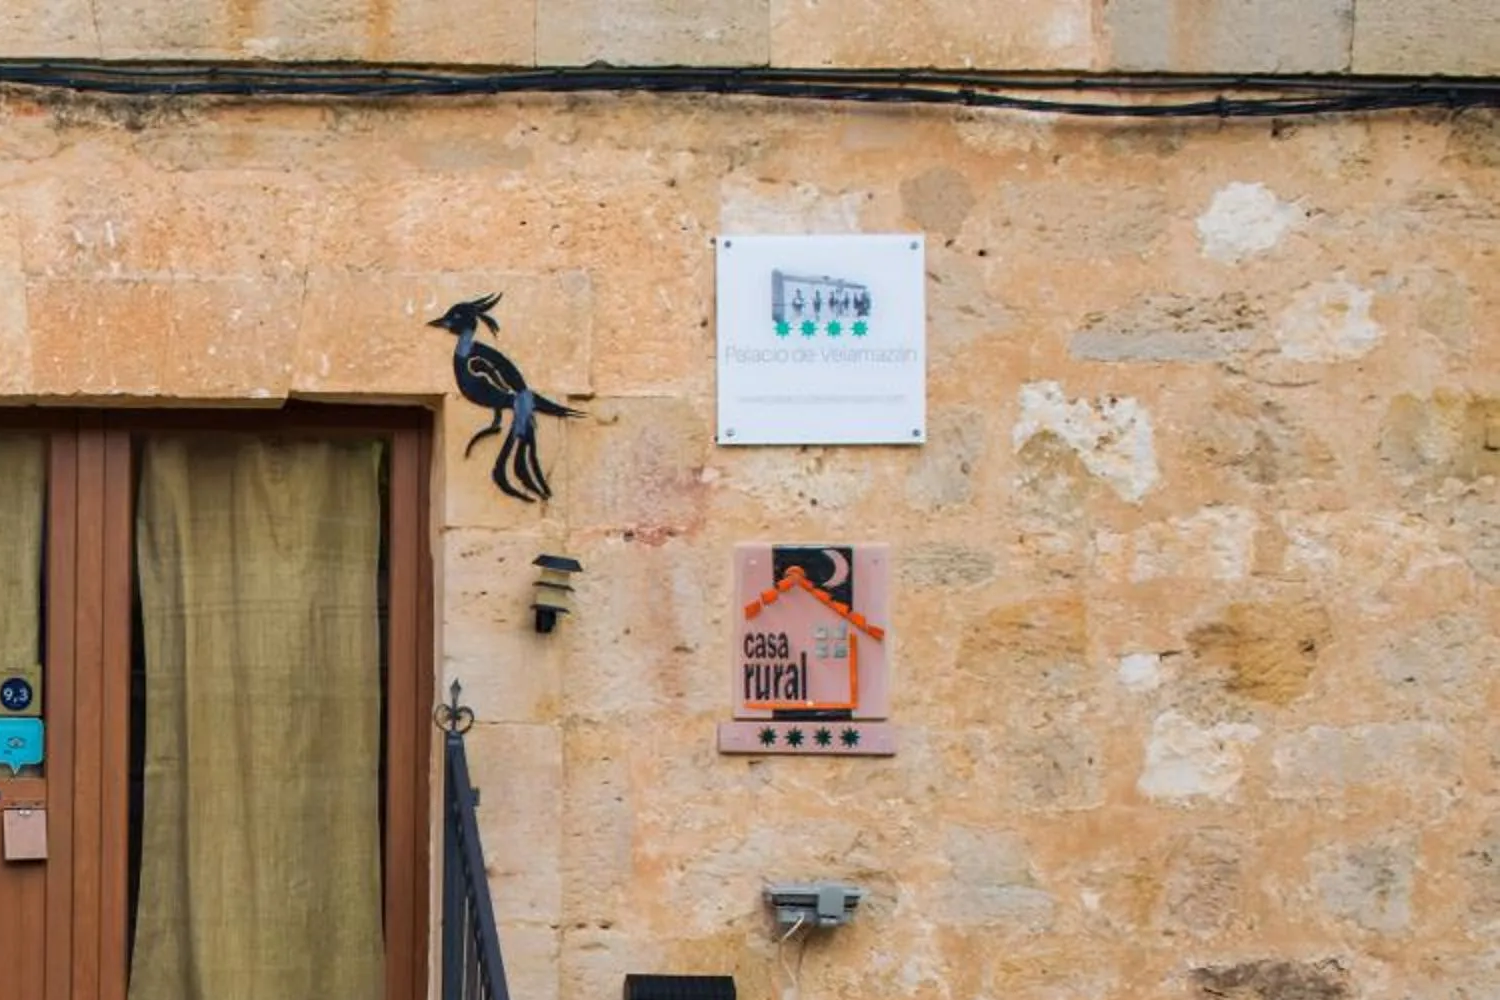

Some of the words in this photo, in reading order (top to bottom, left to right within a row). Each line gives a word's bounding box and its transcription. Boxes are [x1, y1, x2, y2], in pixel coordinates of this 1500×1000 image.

[724, 345, 789, 363] Palacio
[792, 346, 815, 363] de
[743, 632, 789, 659] casa
[743, 652, 807, 701] rural
[3, 687, 28, 705] 9,3
